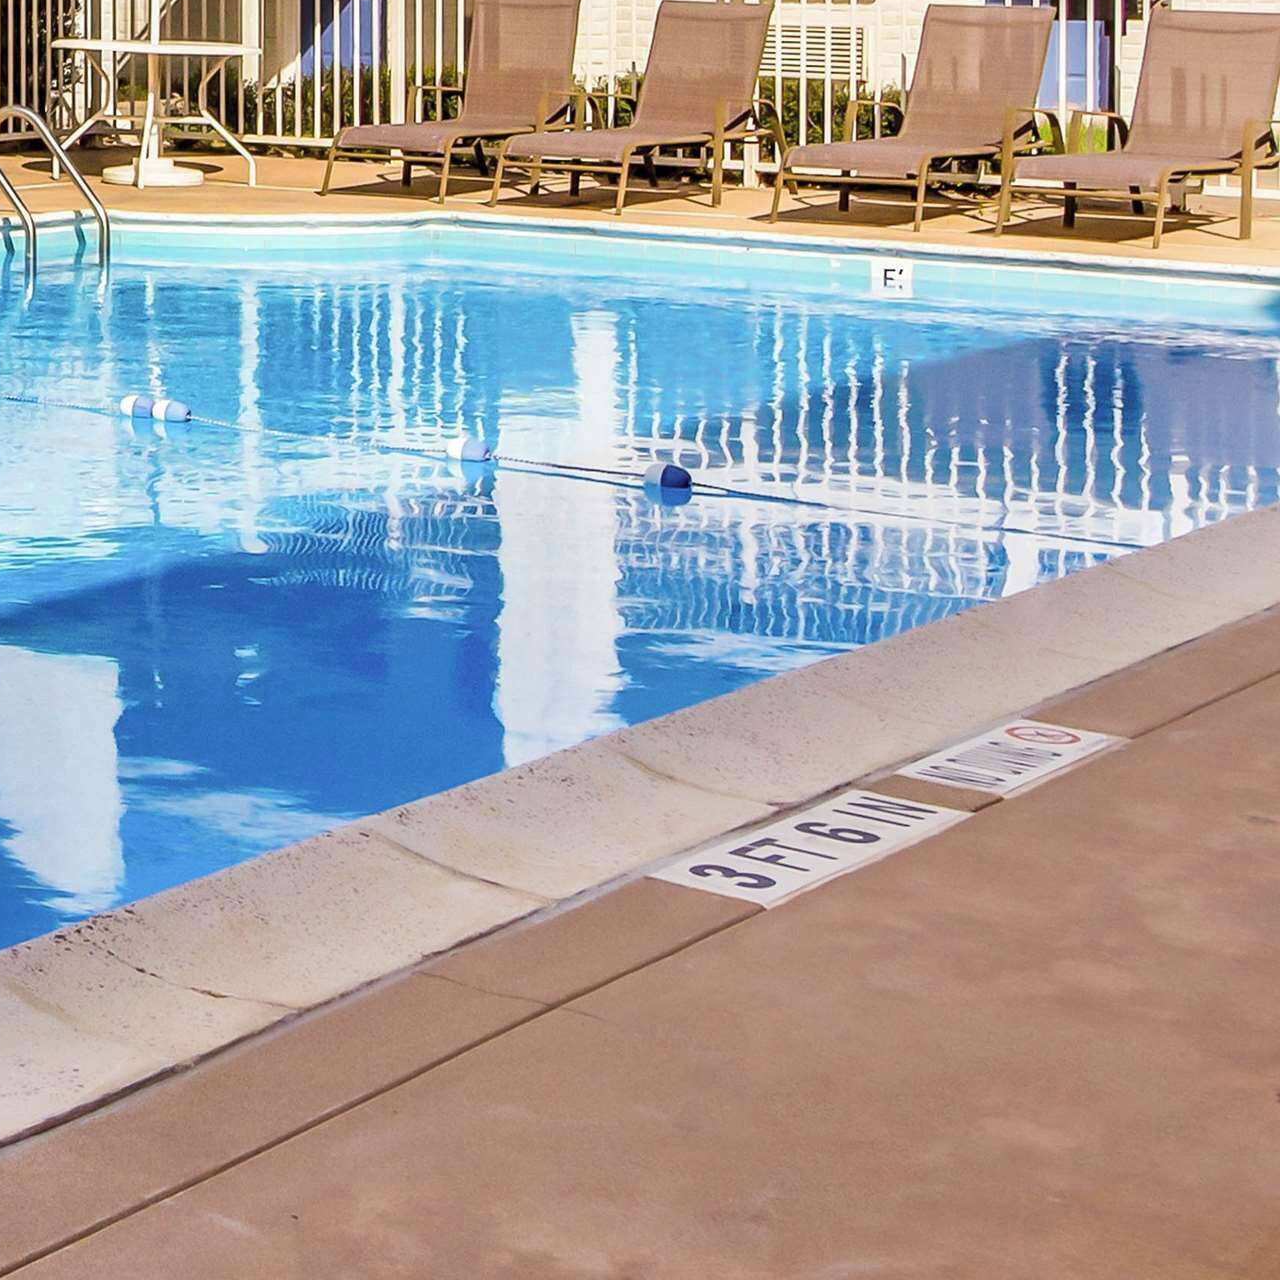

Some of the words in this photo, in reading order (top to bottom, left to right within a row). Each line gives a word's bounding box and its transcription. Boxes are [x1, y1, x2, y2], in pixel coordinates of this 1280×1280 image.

[832, 796, 939, 827] IN
[793, 821, 881, 844] 6
[728, 837, 839, 872] FT
[689, 864, 777, 889] 3
